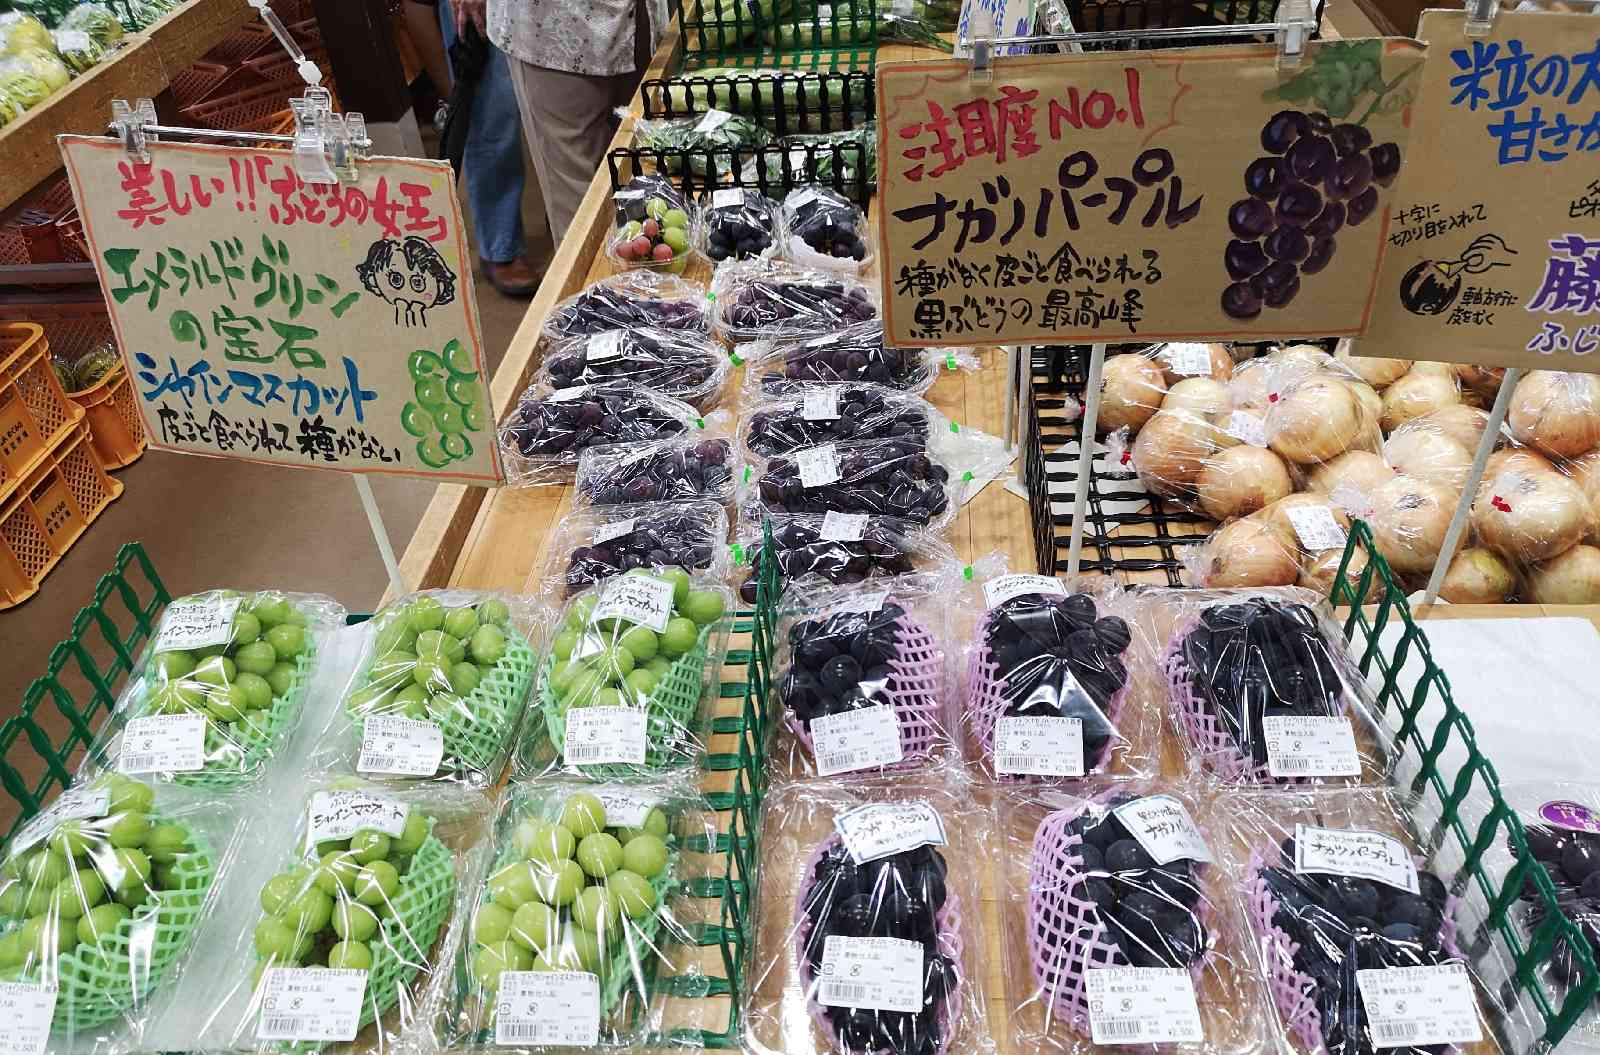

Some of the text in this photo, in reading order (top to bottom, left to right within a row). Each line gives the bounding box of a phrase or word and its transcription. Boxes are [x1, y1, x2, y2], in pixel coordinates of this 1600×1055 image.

[899, 67, 1145, 182] 注目度 NO.1
[891, 148, 1204, 254] ナガノパープル
[1388, 203, 1488, 248] 切り目を入れて
[1392, 203, 1440, 227] 十字に
[103, 233, 362, 318] エメラルドグリーン
[895, 241, 1162, 298] 種がなく皮ごと食べられる
[169, 305, 327, 370] の宝石
[911, 286, 1144, 339] 黒ぶどうの最高峰
[1446, 305, 1495, 326] 皮をむく
[135, 350, 379, 424] シャインマスカット
